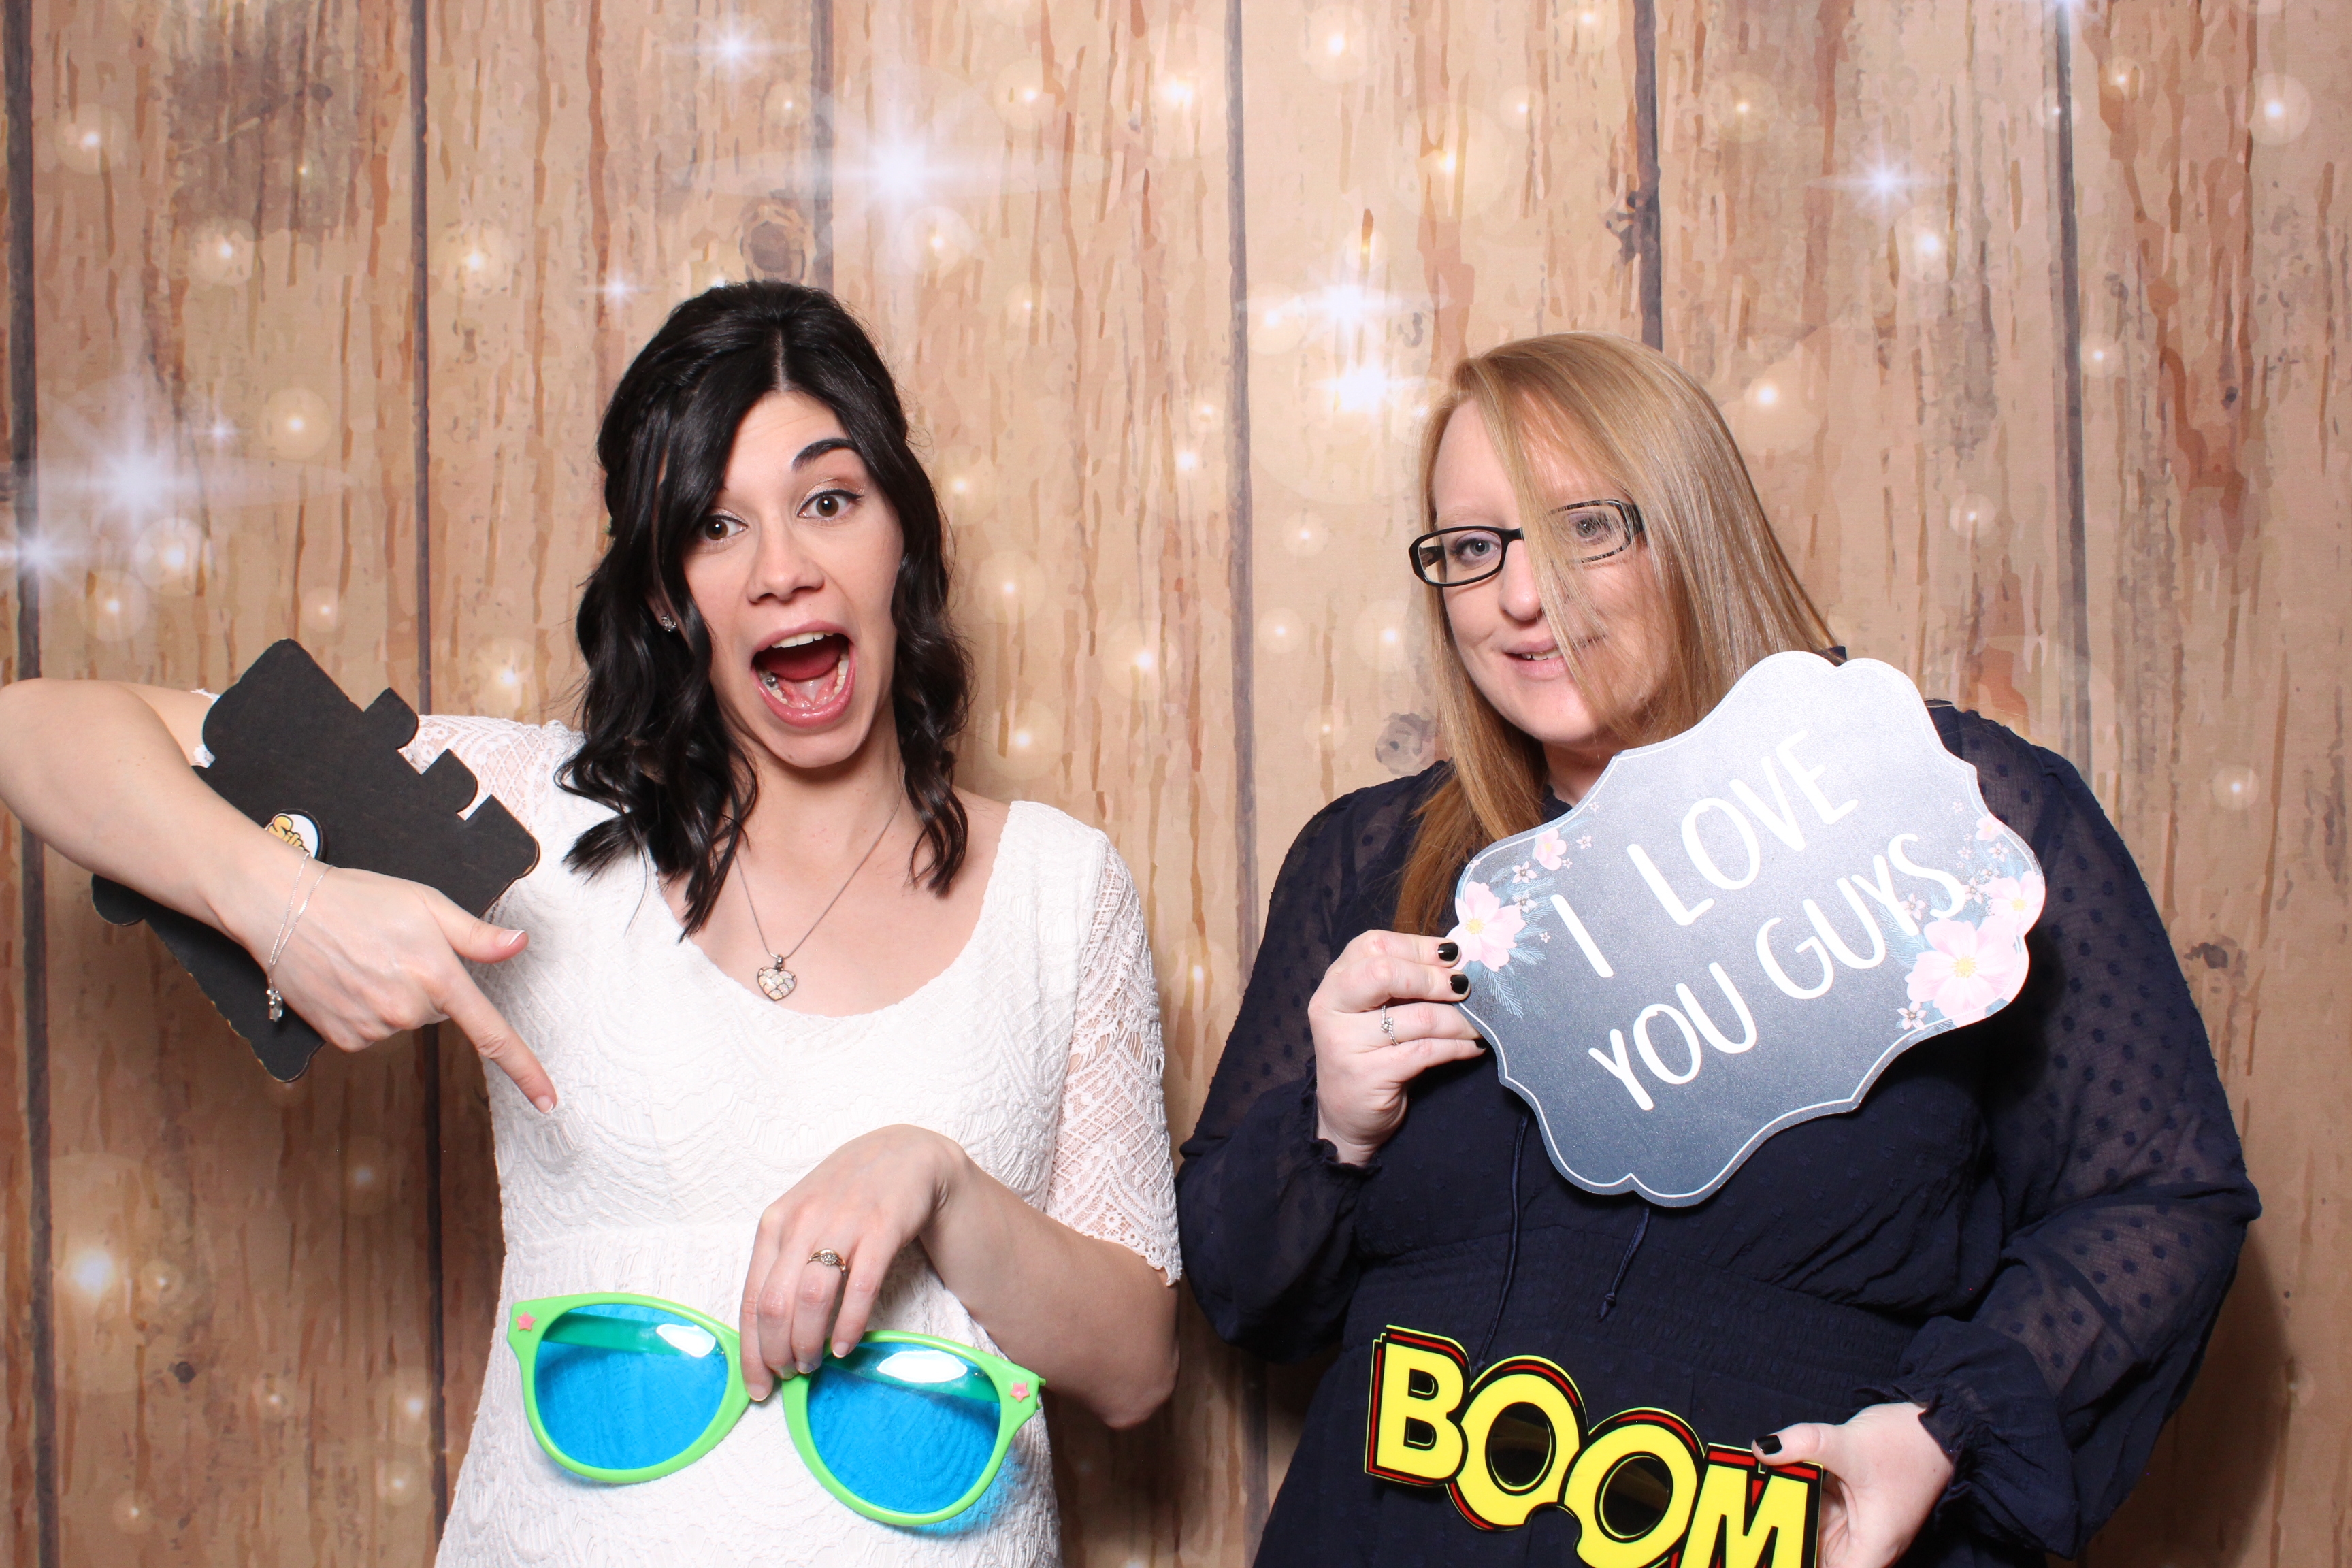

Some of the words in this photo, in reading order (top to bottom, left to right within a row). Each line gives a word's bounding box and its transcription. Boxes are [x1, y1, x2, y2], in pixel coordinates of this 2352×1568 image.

[1550, 894, 1614, 979] I
[1627, 730, 1859, 926] LOVE
[1588, 962, 1757, 1111] YOU
[1755, 832, 1967, 1000] GUYS
[1368, 1330, 1818, 1568] BOOM
